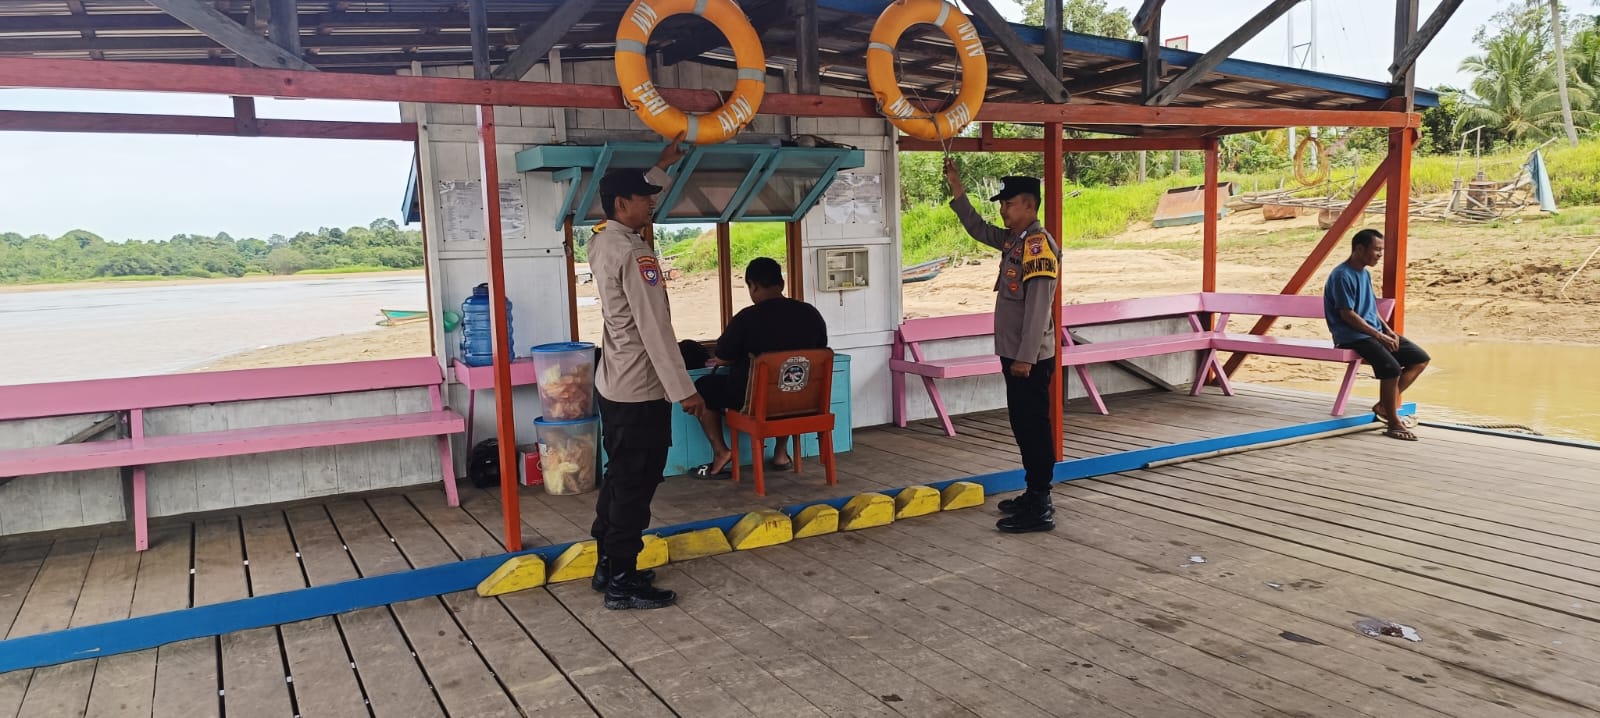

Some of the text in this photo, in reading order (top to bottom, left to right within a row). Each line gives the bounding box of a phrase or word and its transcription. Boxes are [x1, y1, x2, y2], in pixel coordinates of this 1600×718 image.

[957, 21, 985, 57] ALAN
[632, 80, 670, 117] FERI
[717, 94, 753, 137] ALAN
[945, 102, 972, 132] FERI
